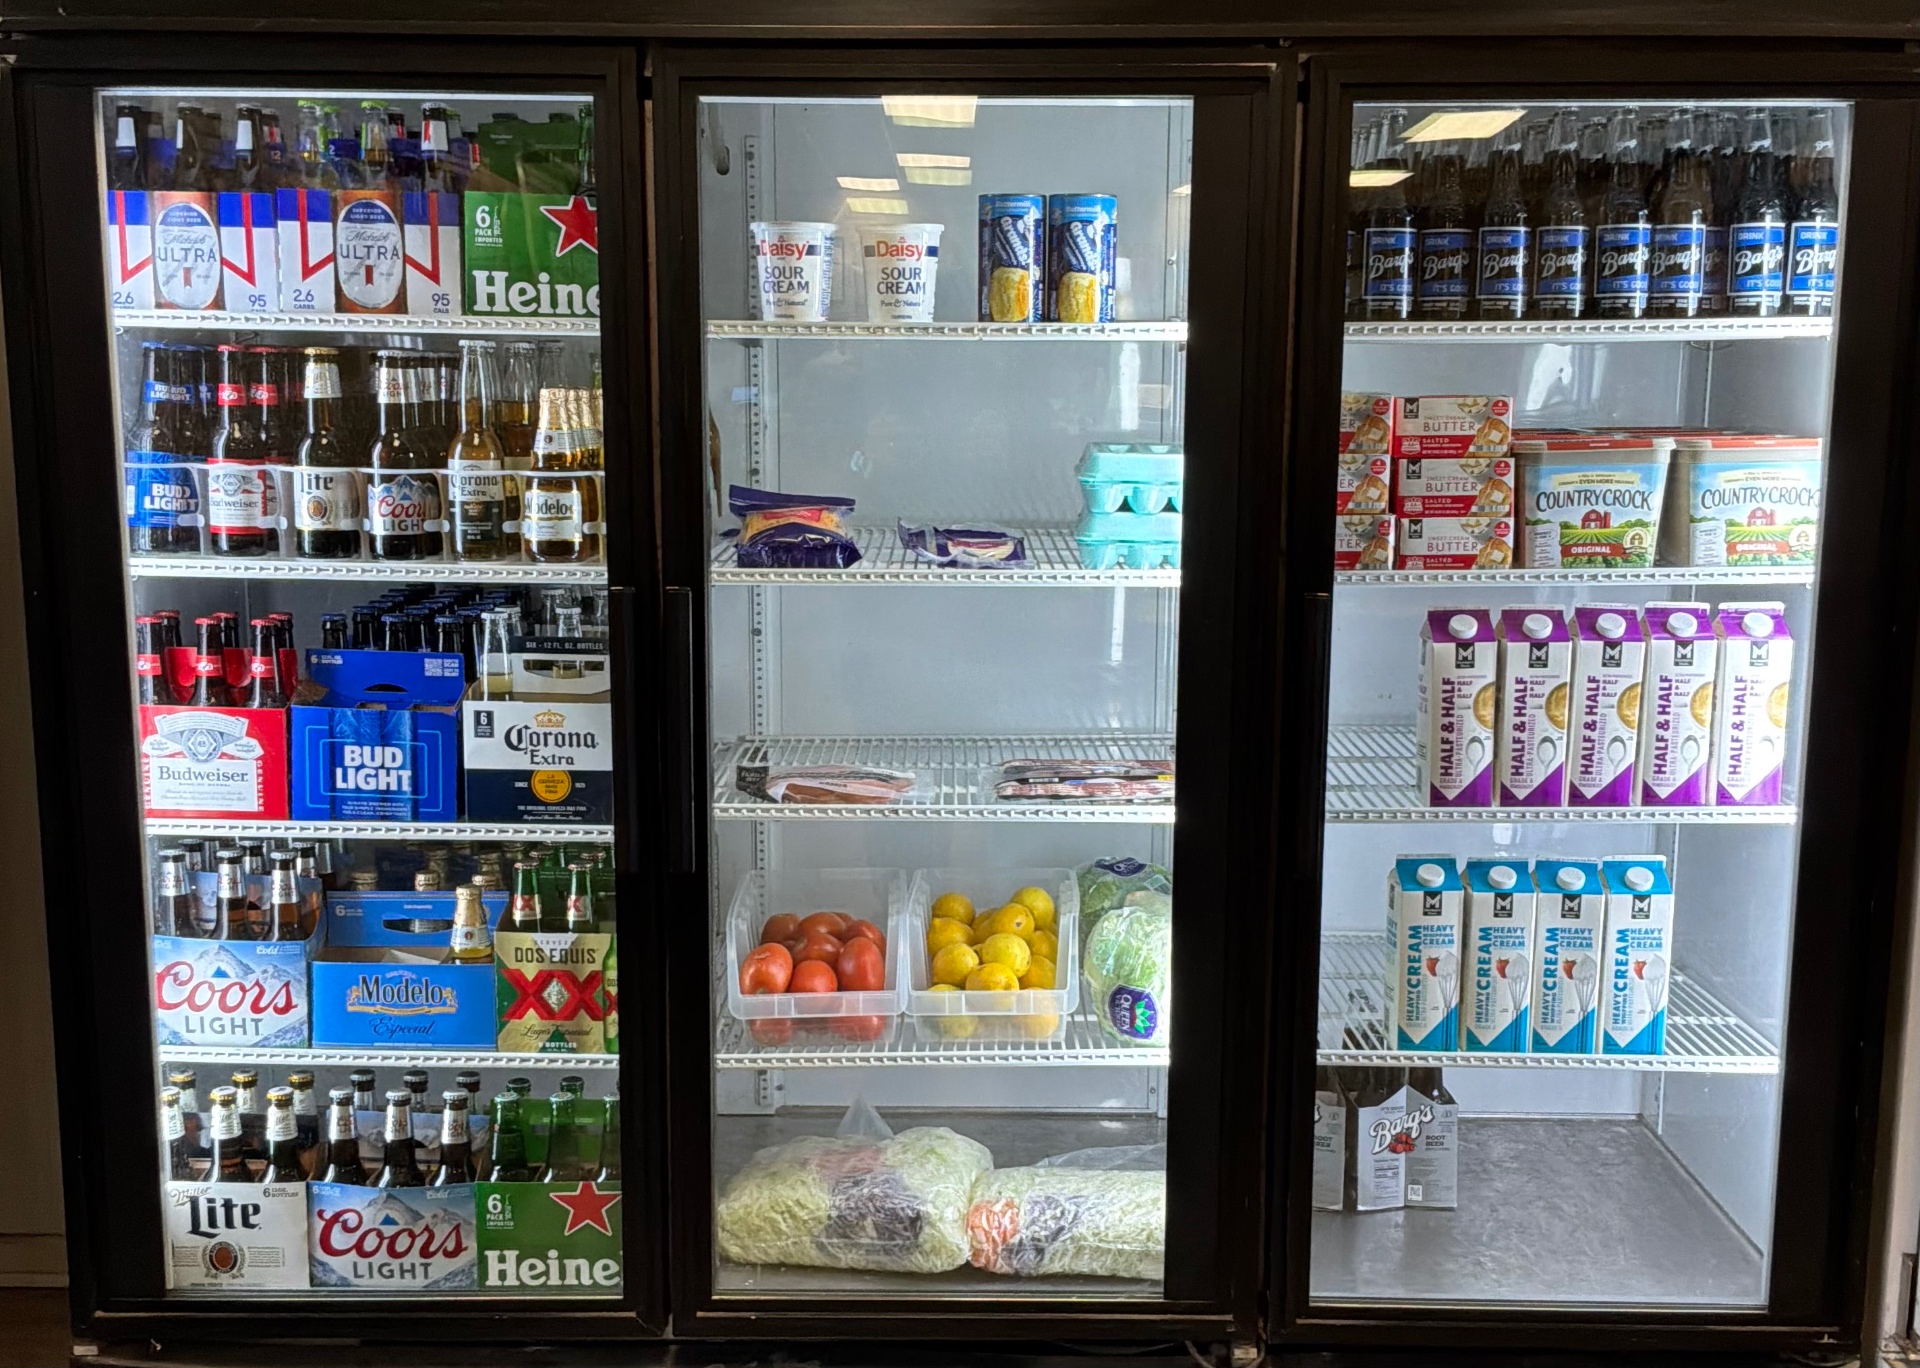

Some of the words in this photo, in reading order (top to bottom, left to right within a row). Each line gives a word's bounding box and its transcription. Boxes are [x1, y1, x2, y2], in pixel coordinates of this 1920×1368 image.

[475, 205, 491, 228] 6
[475, 228, 493, 236] PACK
[1604, 233, 1629, 242] DRINK
[1738, 231, 1764, 240] DRINK
[1801, 231, 1828, 240] DRINK
[158, 246, 217, 263] ULTRA
[340, 244, 401, 260] ULTRA
[760, 240, 807, 260] Daisy
[875, 240, 924, 261] Daisy
[1369, 251, 1414, 279] Barq's
[1423, 251, 1469, 280] Barq's
[1483, 250, 1529, 278] Barq's
[1601, 247, 1650, 276] Barq's
[1652, 247, 1700, 276] Barq's
[764, 266, 804, 280] SOUR
[881, 267, 921, 281] SOUR
[762, 281, 810, 294] CREAM
[876, 281, 926, 295] CREAM
[1747, 279, 1762, 288] IT'S
[113, 291, 134, 304] 2.6
[248, 294, 266, 308] 95
[293, 289, 314, 302] 2.6
[432, 293, 450, 307] 95
[1423, 421, 1475, 432] BUTTER
[152, 483, 191, 498] BUD
[461, 487, 486, 497] Extra
[1425, 482, 1478, 492] BUTTER
[144, 495, 198, 511] LIGHT
[1427, 542, 1478, 552] BUTTER
[1571, 546, 1612, 554] ORIGINAL
[526, 641, 537, 649] SIX
[577, 642, 604, 650] BOTTLES
[311, 655, 318, 664] 6
[1441, 677, 1456, 718] HALF
[1514, 676, 1528, 718] HALF
[1585, 675, 1600, 716] HALF
[1657, 674, 1673, 716] HALF
[1732, 675, 1748, 716] HALF
[480, 712, 487, 725] 6
[1440, 722, 1455, 733] &
[1513, 720, 1527, 733] &
[1583, 719, 1597, 732] &
[1656, 719, 1671, 732] &
[1731, 719, 1745, 731] &
[504, 724, 597, 755] Corona
[344, 745, 403, 768] BUD
[529, 749, 575, 766] Extra
[1440, 736, 1455, 777] HALF
[1511, 735, 1526, 777] HALF
[1580, 735, 1596, 776] HALF
[1653, 734, 1669, 775] HALF
[1728, 735, 1743, 775] HALF
[158, 765, 249, 782] Budweiser
[335, 767, 412, 792] LIGHT
[257, 760, 265, 812] GENUINE
[335, 905, 346, 917] 6
[256, 945, 280, 955] Cold
[1559, 941, 1593, 949] CREAM
[1630, 941, 1663, 949] CREAM
[515, 947, 545, 963] DOS
[550, 948, 596, 964] EQUIS
[1406, 924, 1422, 989] CREAM
[1477, 926, 1493, 991] CREAM
[1543, 927, 1560, 991] CREAM
[1614, 928, 1630, 993] CREAM
[155, 960, 299, 1016] Coors
[360, 974, 444, 1004] Modelo
[501, 968, 604, 1021] XX
[1120, 994, 1133, 1030] QUEEN
[1406, 991, 1415, 1022] HEAVY
[1475, 992, 1484, 1023] HEAVY
[1541, 992, 1549, 1024] HEAVY
[1612, 993, 1620, 1025] HEAVY
[184, 1016, 262, 1036] LIGHT
[370, 1016, 435, 1039] Especial
[1368, 1104, 1435, 1155] Barq's
[170, 1187, 212, 1207] Miller
[263, 1187, 271, 1198] 6
[312, 1186, 319, 1194] 6
[426, 1190, 449, 1199] Cold
[487, 1194, 502, 1214] 6
[187, 1195, 261, 1239] Lite
[316, 1208, 469, 1260] Coors
[353, 1261, 433, 1280] LIGHT
